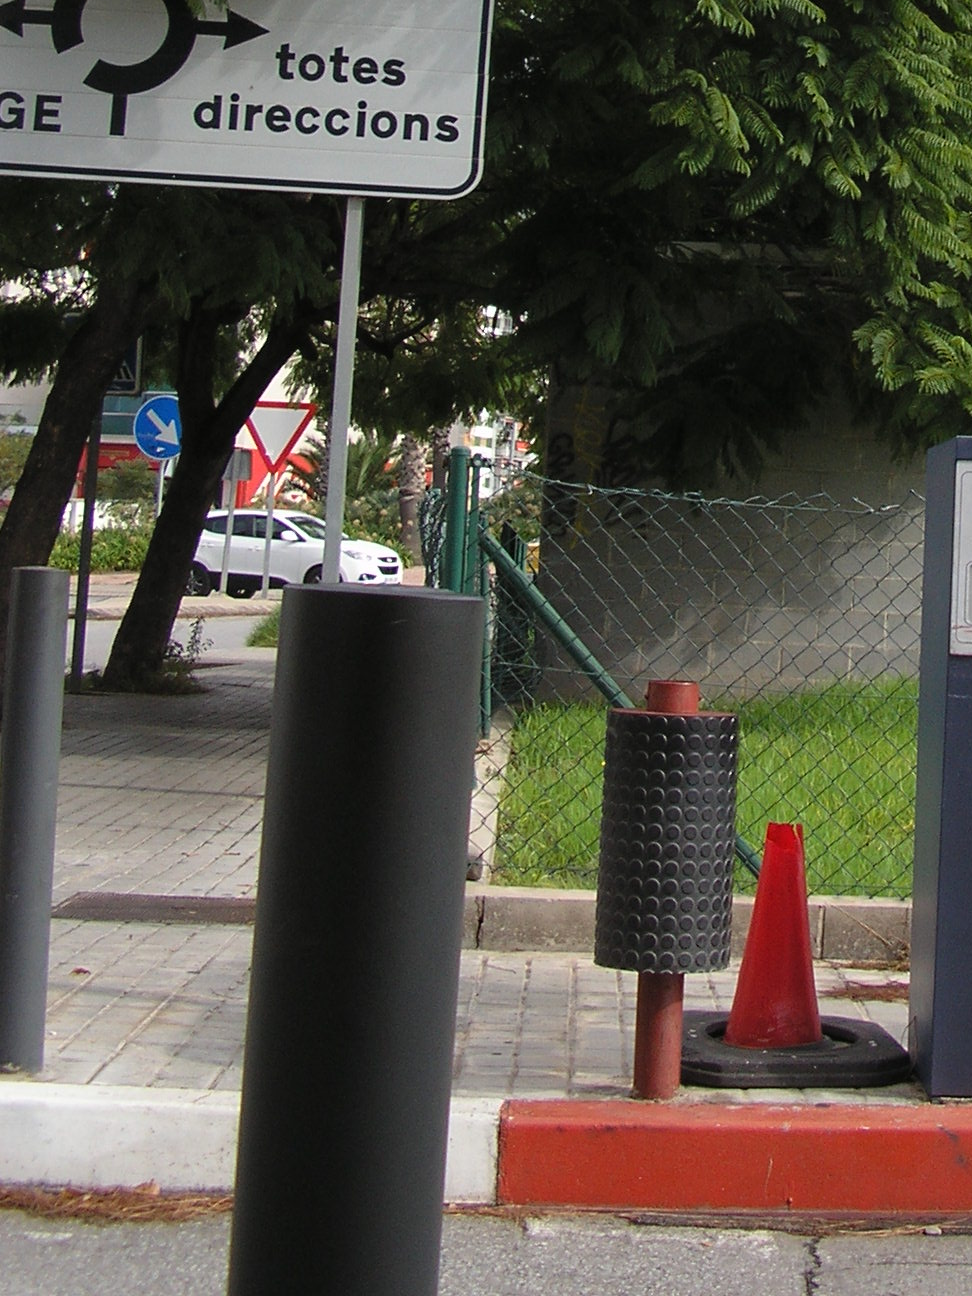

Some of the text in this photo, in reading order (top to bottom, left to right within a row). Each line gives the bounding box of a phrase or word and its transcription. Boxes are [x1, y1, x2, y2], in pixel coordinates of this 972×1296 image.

[275, 43, 407, 87] totes
[0, 91, 63, 133] GE
[193, 92, 460, 143] direccions
